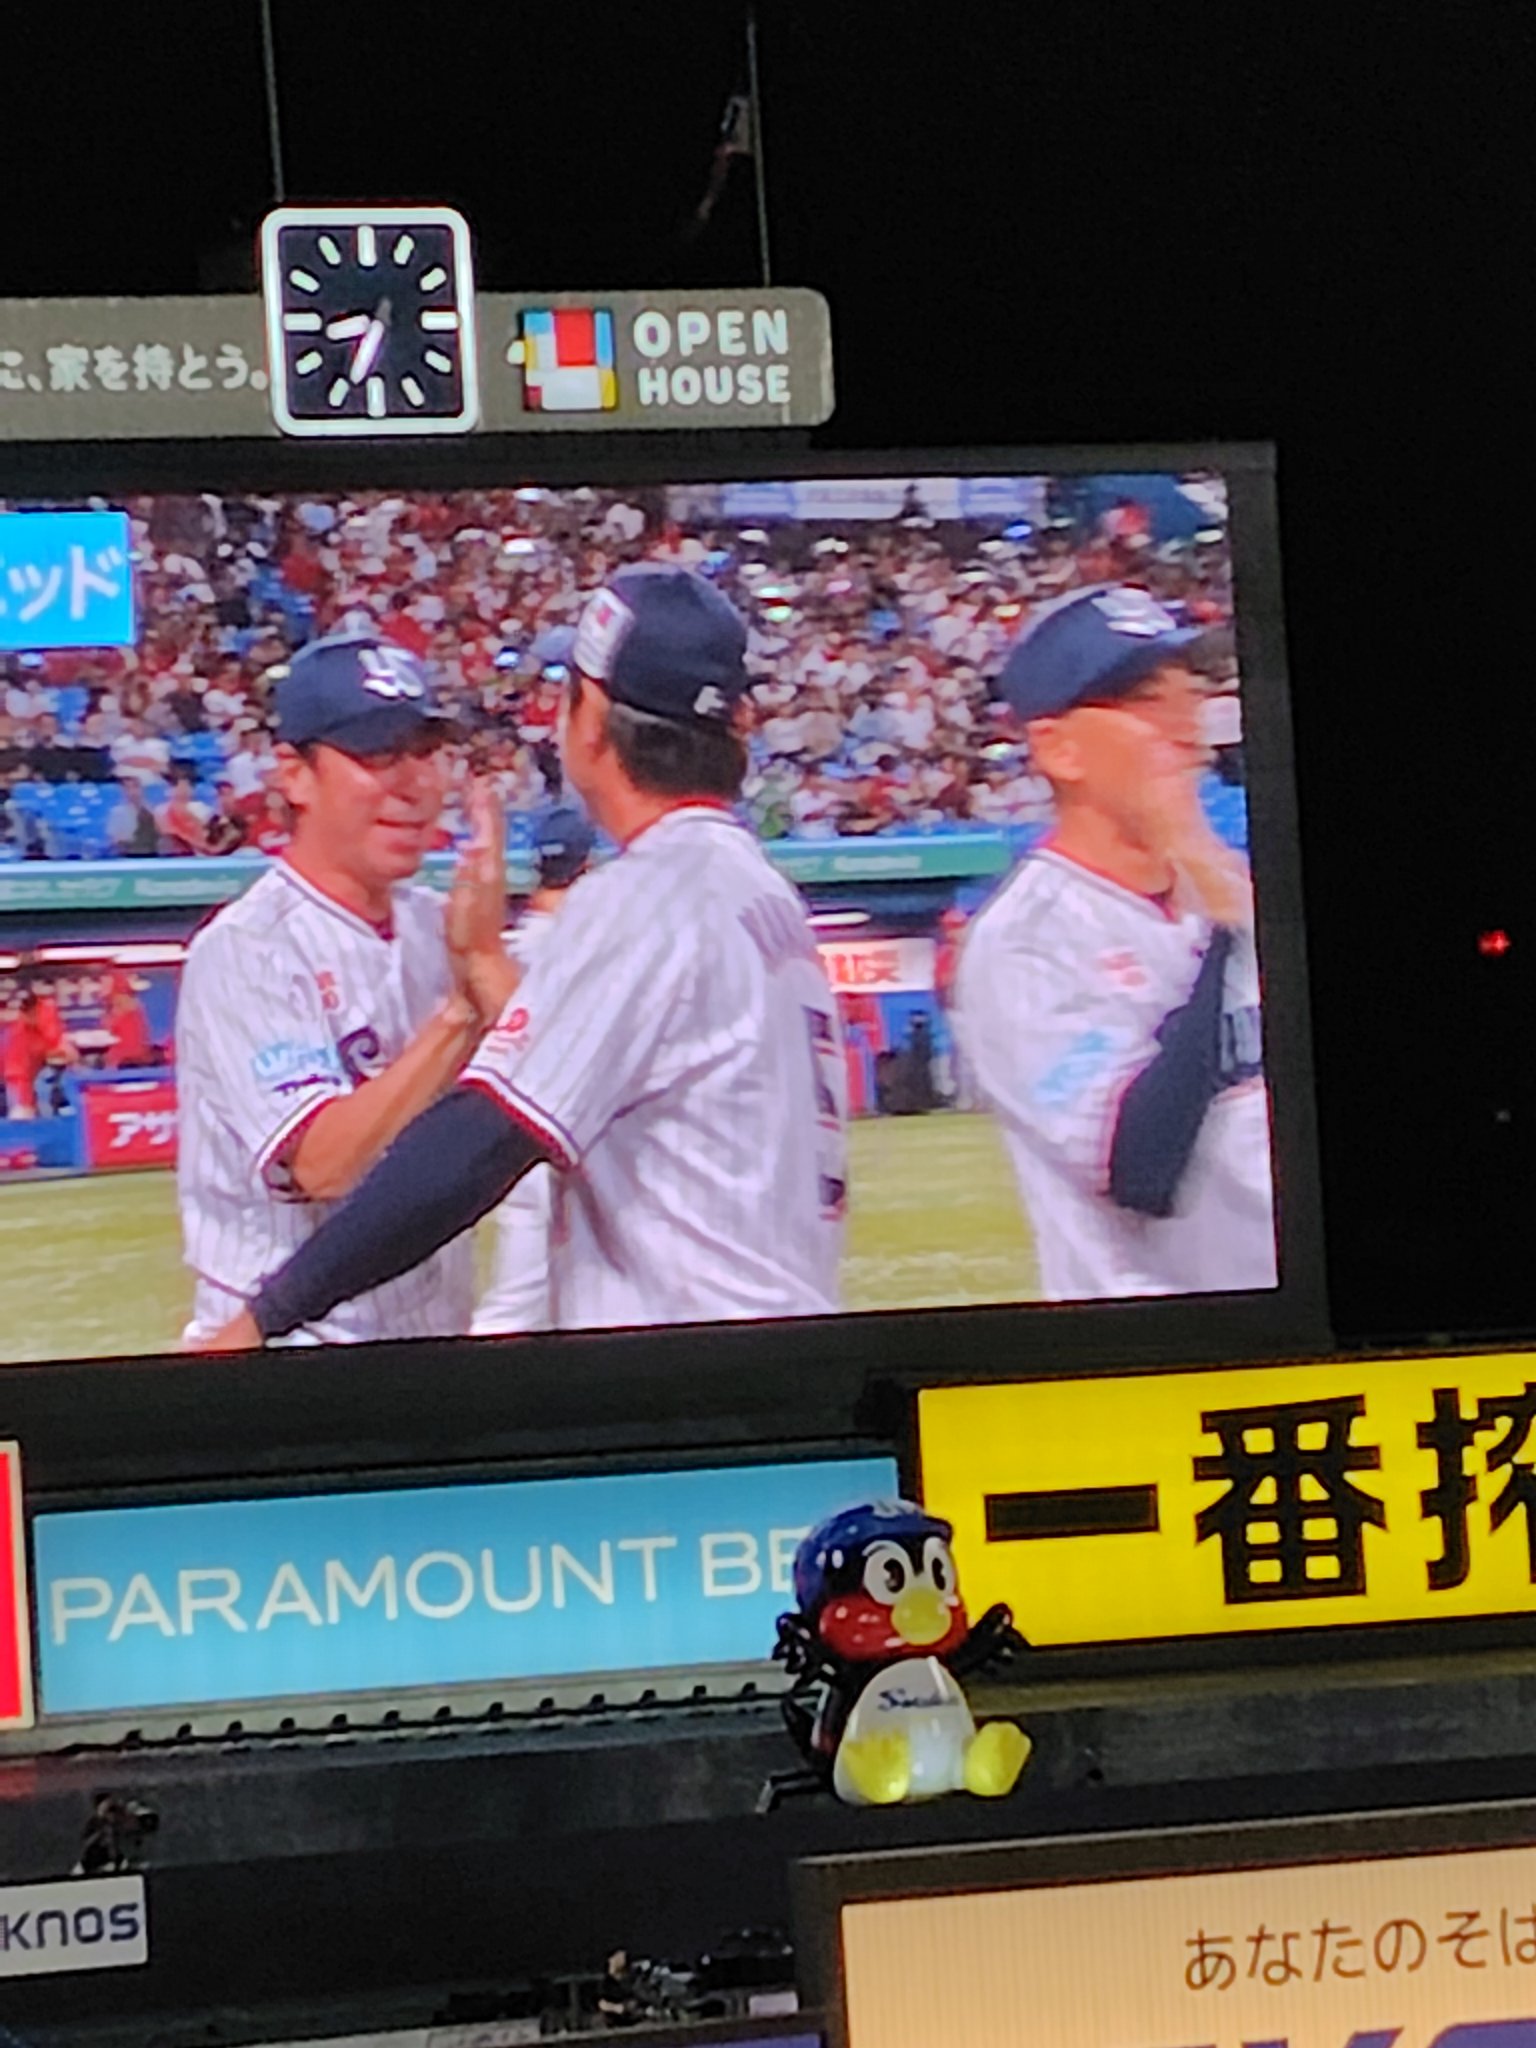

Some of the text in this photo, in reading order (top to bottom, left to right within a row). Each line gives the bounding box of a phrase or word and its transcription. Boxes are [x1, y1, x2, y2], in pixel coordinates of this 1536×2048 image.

[633, 309, 789, 358] OPEN
[637, 363, 791, 405] HOUSE
[0, 544, 122, 623] ッド
[49, 1535, 678, 1646] PARAMOUNT
